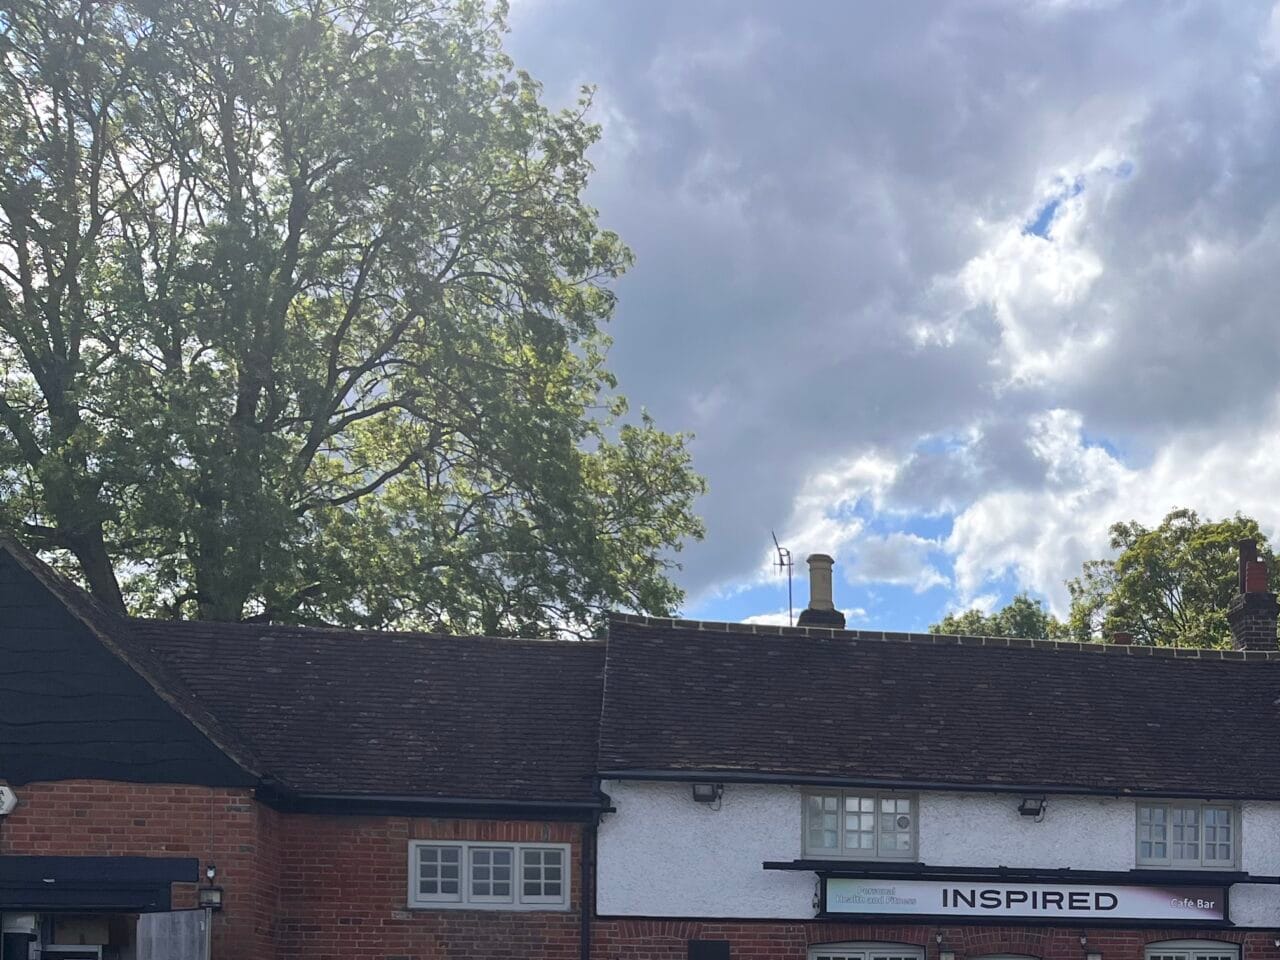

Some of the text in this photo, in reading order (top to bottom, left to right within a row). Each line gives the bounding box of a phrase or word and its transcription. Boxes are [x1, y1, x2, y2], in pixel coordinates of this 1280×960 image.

[867, 895, 884, 905] and
[942, 888, 1119, 911] INSPIRED
[1170, 897, 1215, 910] Café Bar
